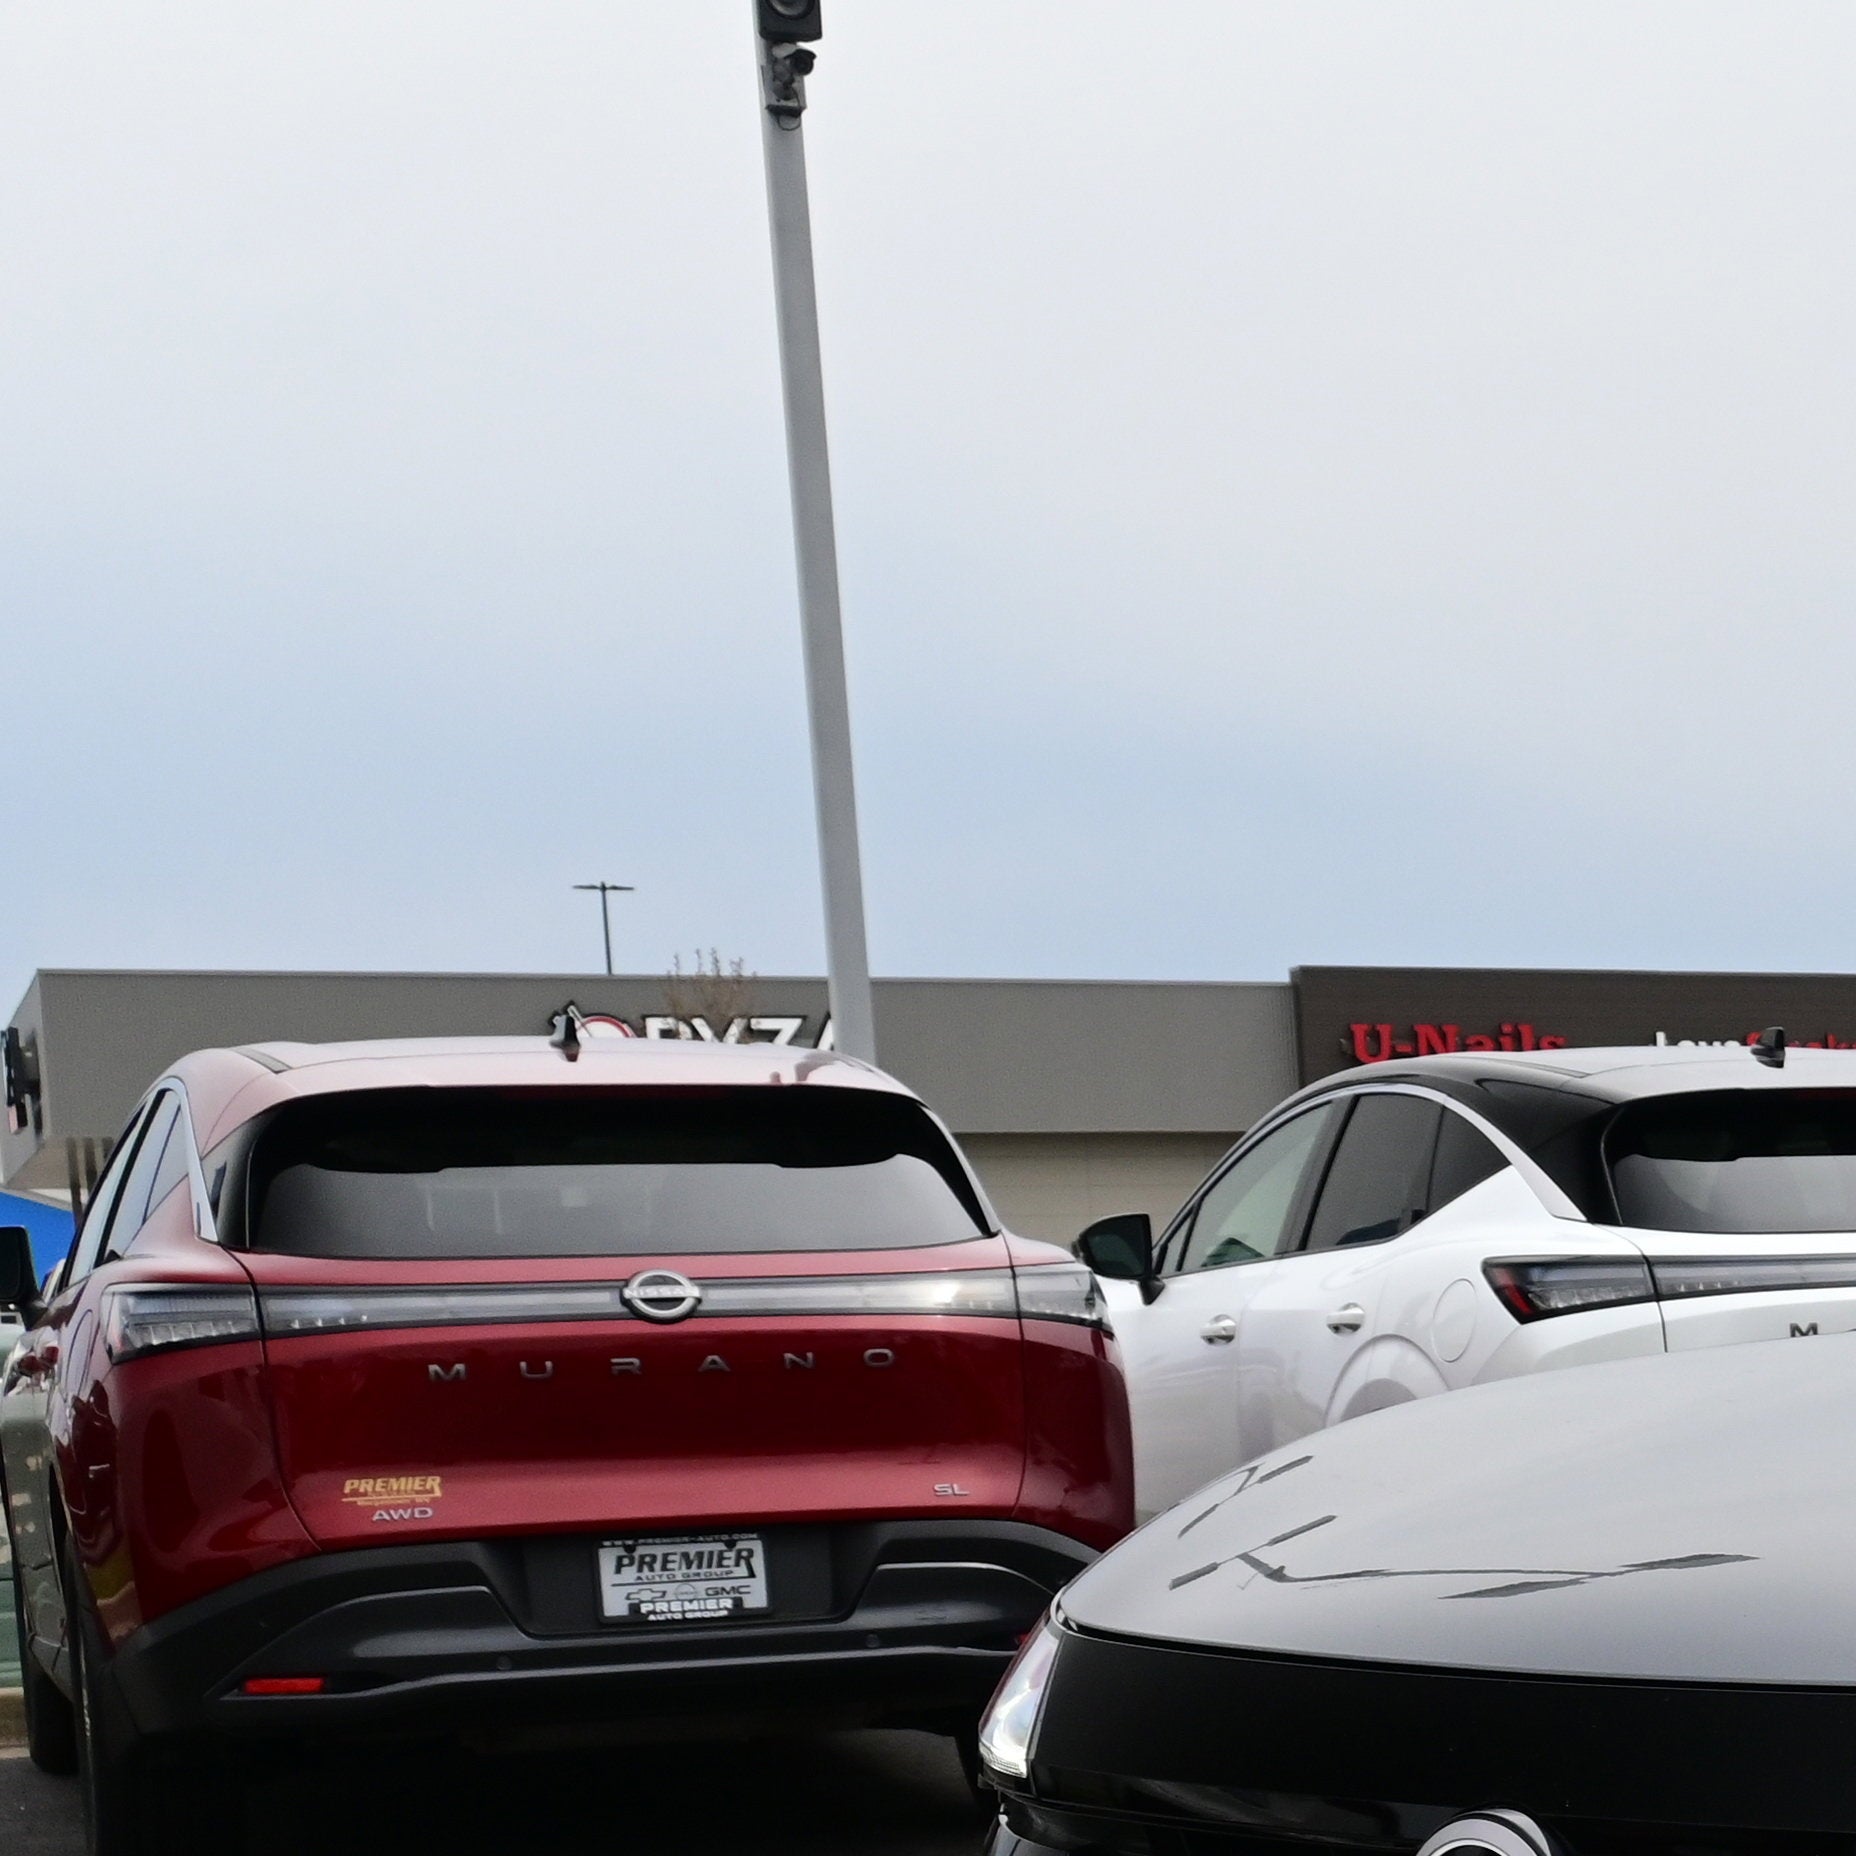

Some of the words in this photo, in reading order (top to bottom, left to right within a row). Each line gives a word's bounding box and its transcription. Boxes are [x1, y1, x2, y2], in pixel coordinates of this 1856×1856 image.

[427, 1347, 896, 1382] MURANO
[343, 1475, 442, 1497] PREMIER
[933, 1483, 970, 1496] SL
[372, 1507, 433, 1521] AWD
[614, 1548, 757, 1578] PREMIER
[635, 1573, 676, 1582] AUTO
[681, 1569, 734, 1580] GROUP
[704, 1584, 752, 1597] GMC
[639, 1597, 733, 1614] PREMIER
[647, 1612, 684, 1621] AUTO
[684, 1609, 729, 1619] GROUP
